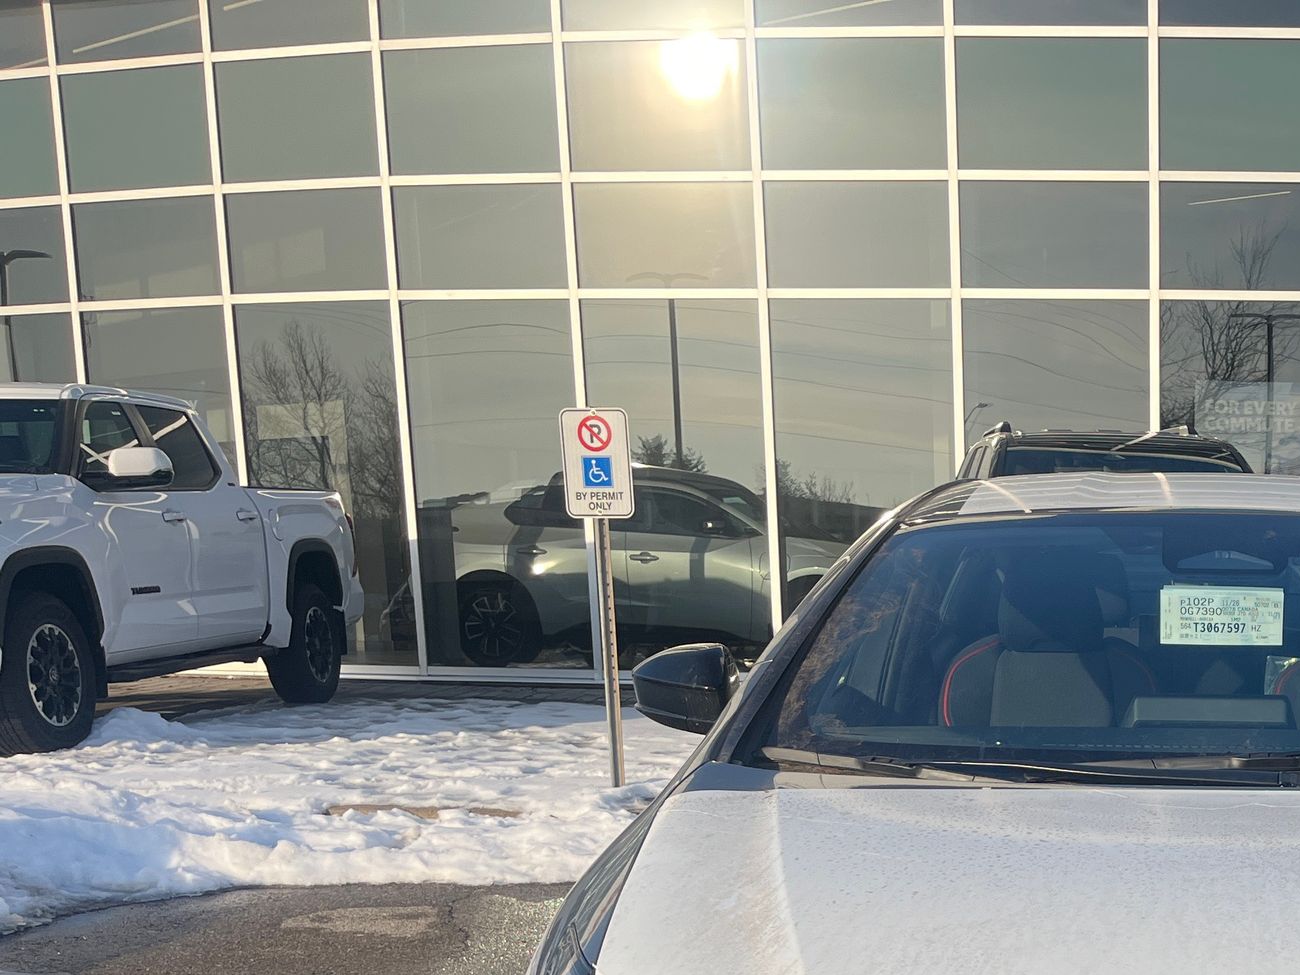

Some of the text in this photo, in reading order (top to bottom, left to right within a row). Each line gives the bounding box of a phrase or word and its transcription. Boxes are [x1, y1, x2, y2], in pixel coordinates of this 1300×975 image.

[1205, 399, 1297, 415] FOR EVERY
[575, 492, 624, 500] BY PERMIT
[588, 502, 612, 510] ONLY
[1193, 622, 1246, 633] T3067597
